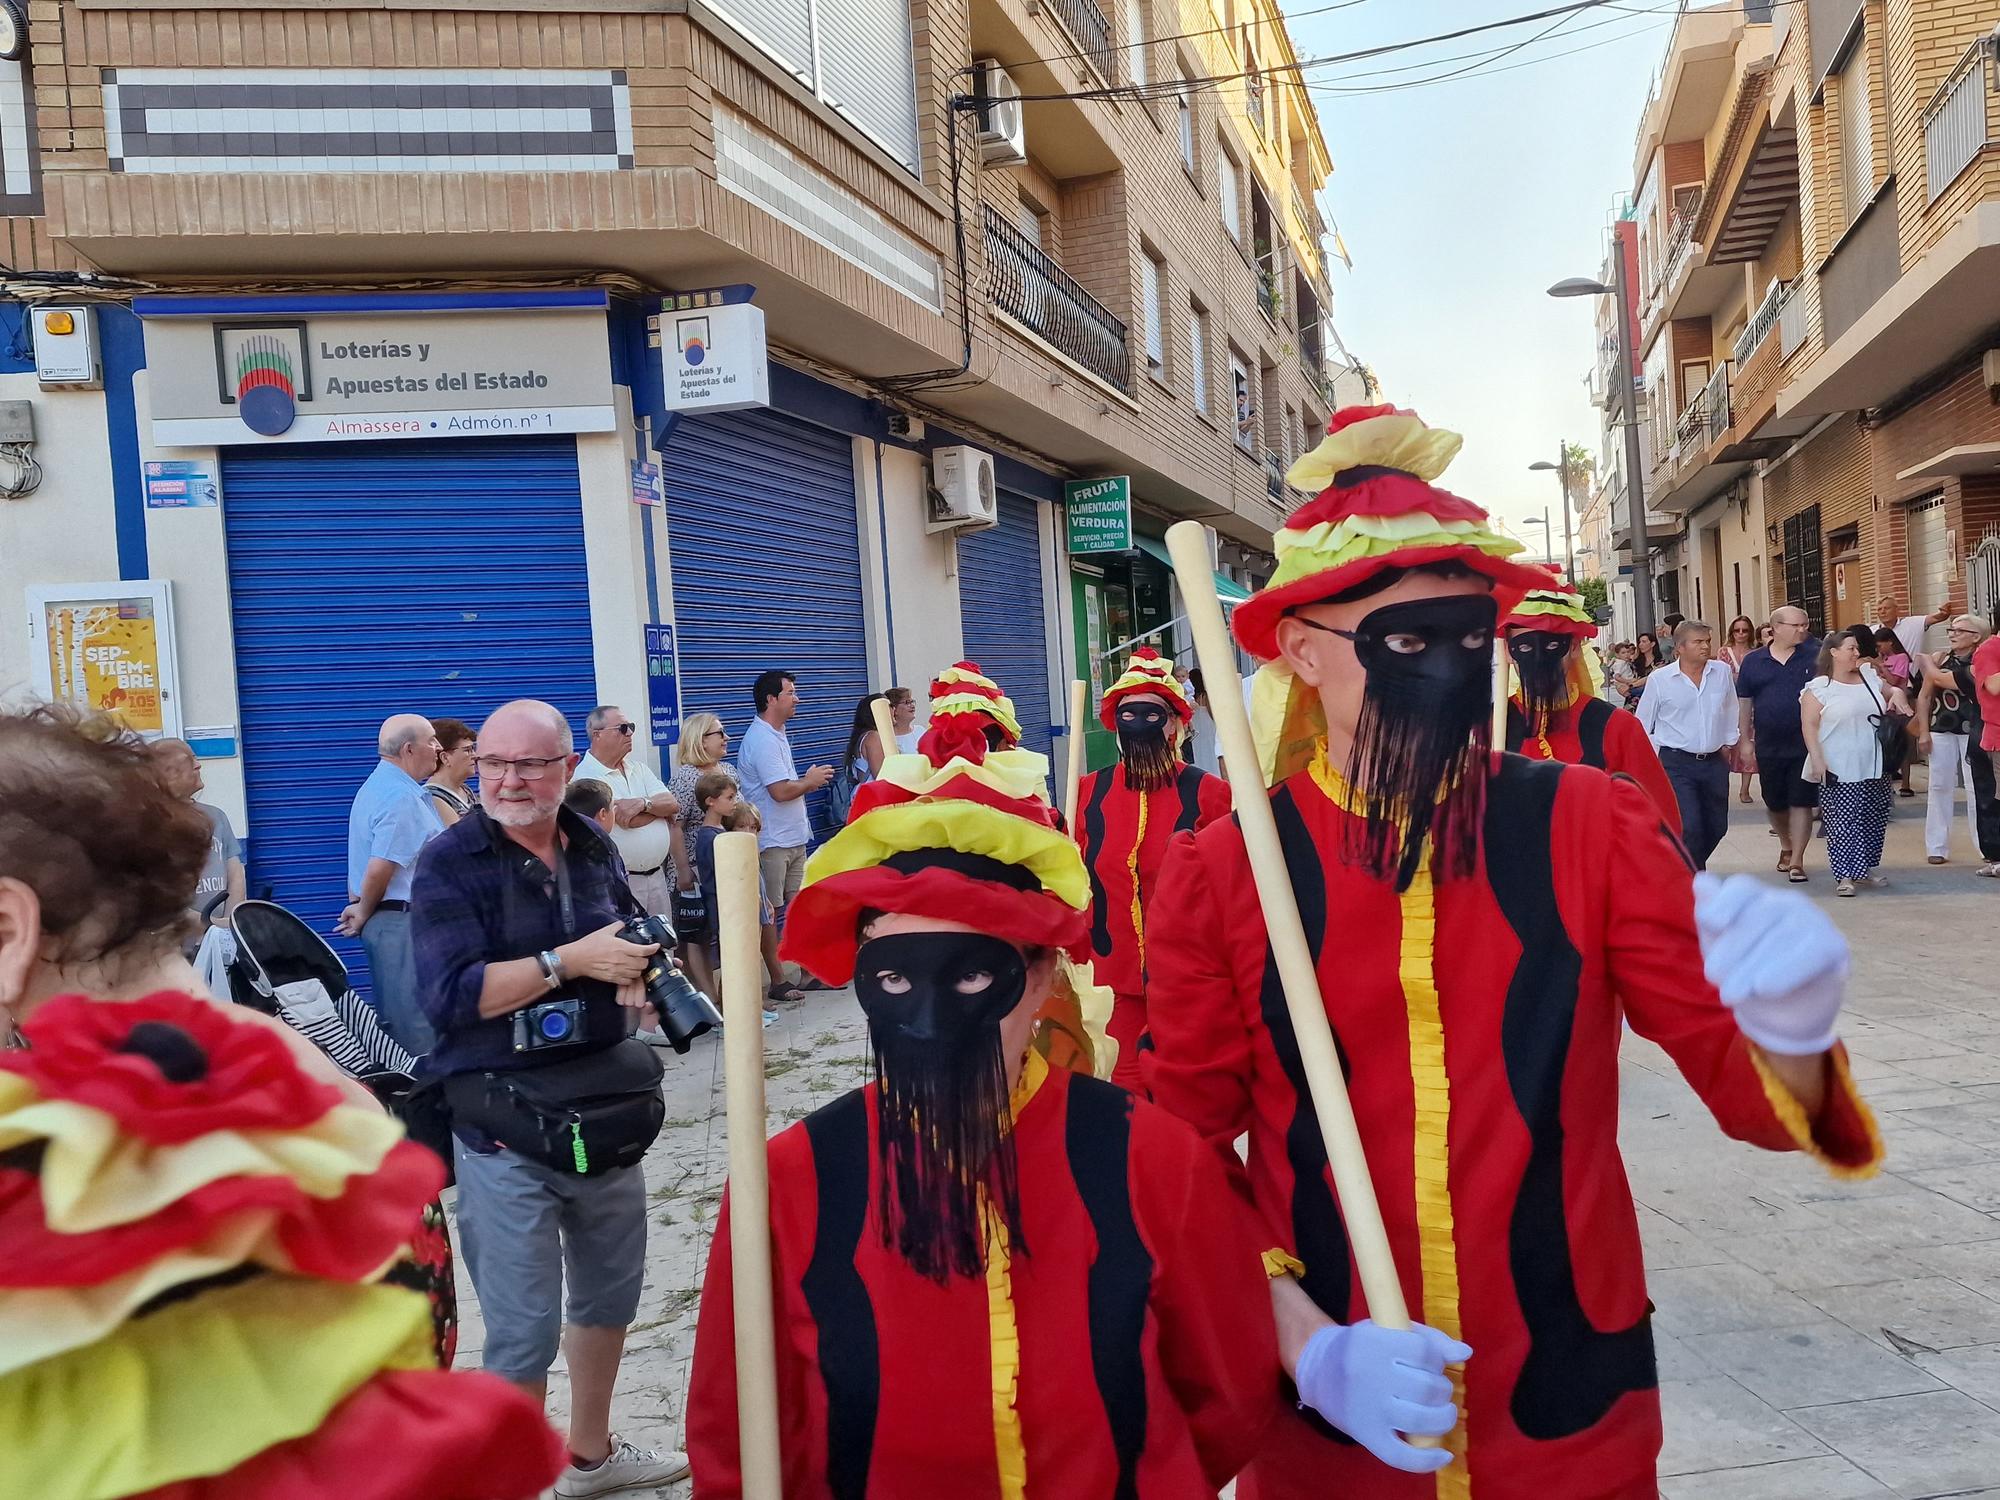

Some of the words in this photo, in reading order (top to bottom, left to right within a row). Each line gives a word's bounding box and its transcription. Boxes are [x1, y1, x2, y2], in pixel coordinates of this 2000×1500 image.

[320, 340, 411, 359] Loterías
[419, 343, 431, 362] y
[716, 366, 722, 375] y
[326, 376, 429, 399] Apuestas
[435, 372, 468, 391] del
[474, 370, 548, 390] Estado
[680, 377, 721, 389] Apuestas
[722, 374, 736, 384] del
[680, 389, 710, 399] Estado
[546, 413, 553, 427] 1
[1073, 480, 1119, 501] FRUTA
[1070, 498, 1125, 514] ALIMENTACIÓN
[1071, 517, 1124, 529] VERDURA
[1073, 534, 1102, 542] SERVICIO,
[1102, 532, 1124, 540] PRECIO
[1090, 541, 1115, 549] CALIDAD
[85, 646, 130, 662] SEP-
[96, 660, 151, 676] TIEM-
[118, 674, 154, 689] BRE
[128, 695, 155, 708] 105
